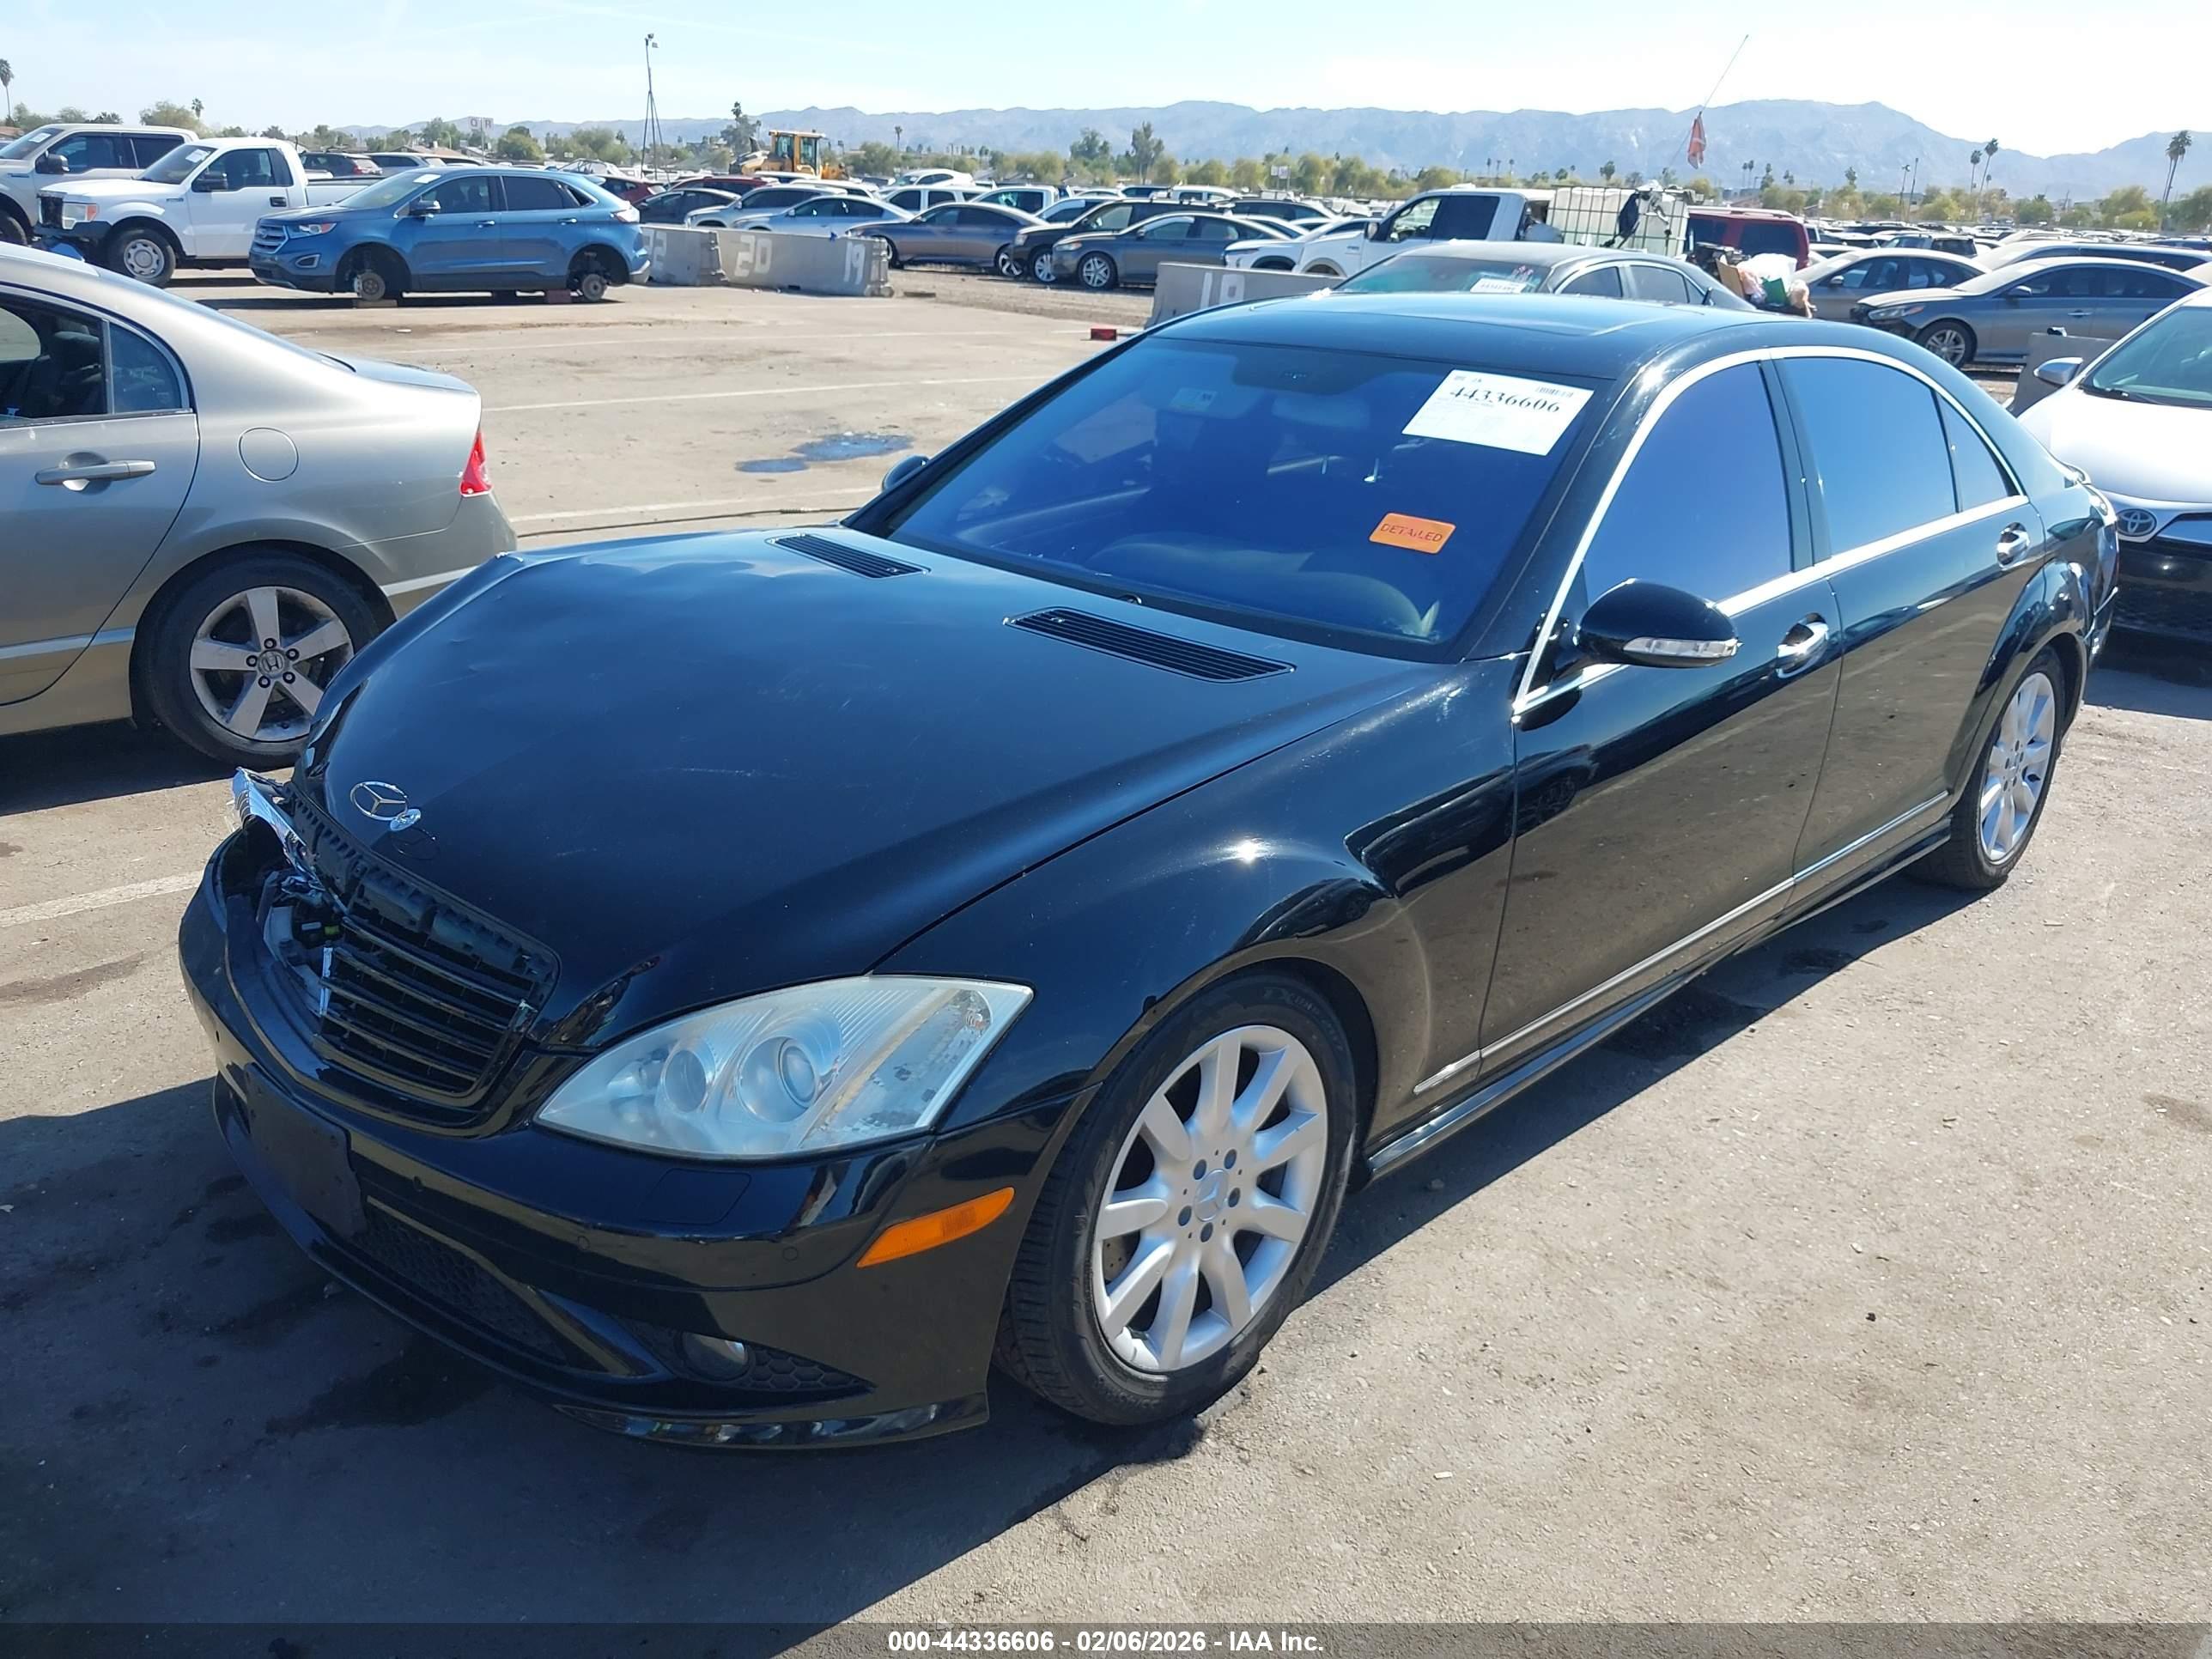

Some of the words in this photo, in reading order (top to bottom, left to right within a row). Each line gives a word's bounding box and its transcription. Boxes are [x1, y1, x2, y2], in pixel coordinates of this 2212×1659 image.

[484, 119, 492, 129] R
[734, 234, 772, 277] 20
[843, 240, 866, 285] 19
[1449, 386, 1560, 413] 44336606
